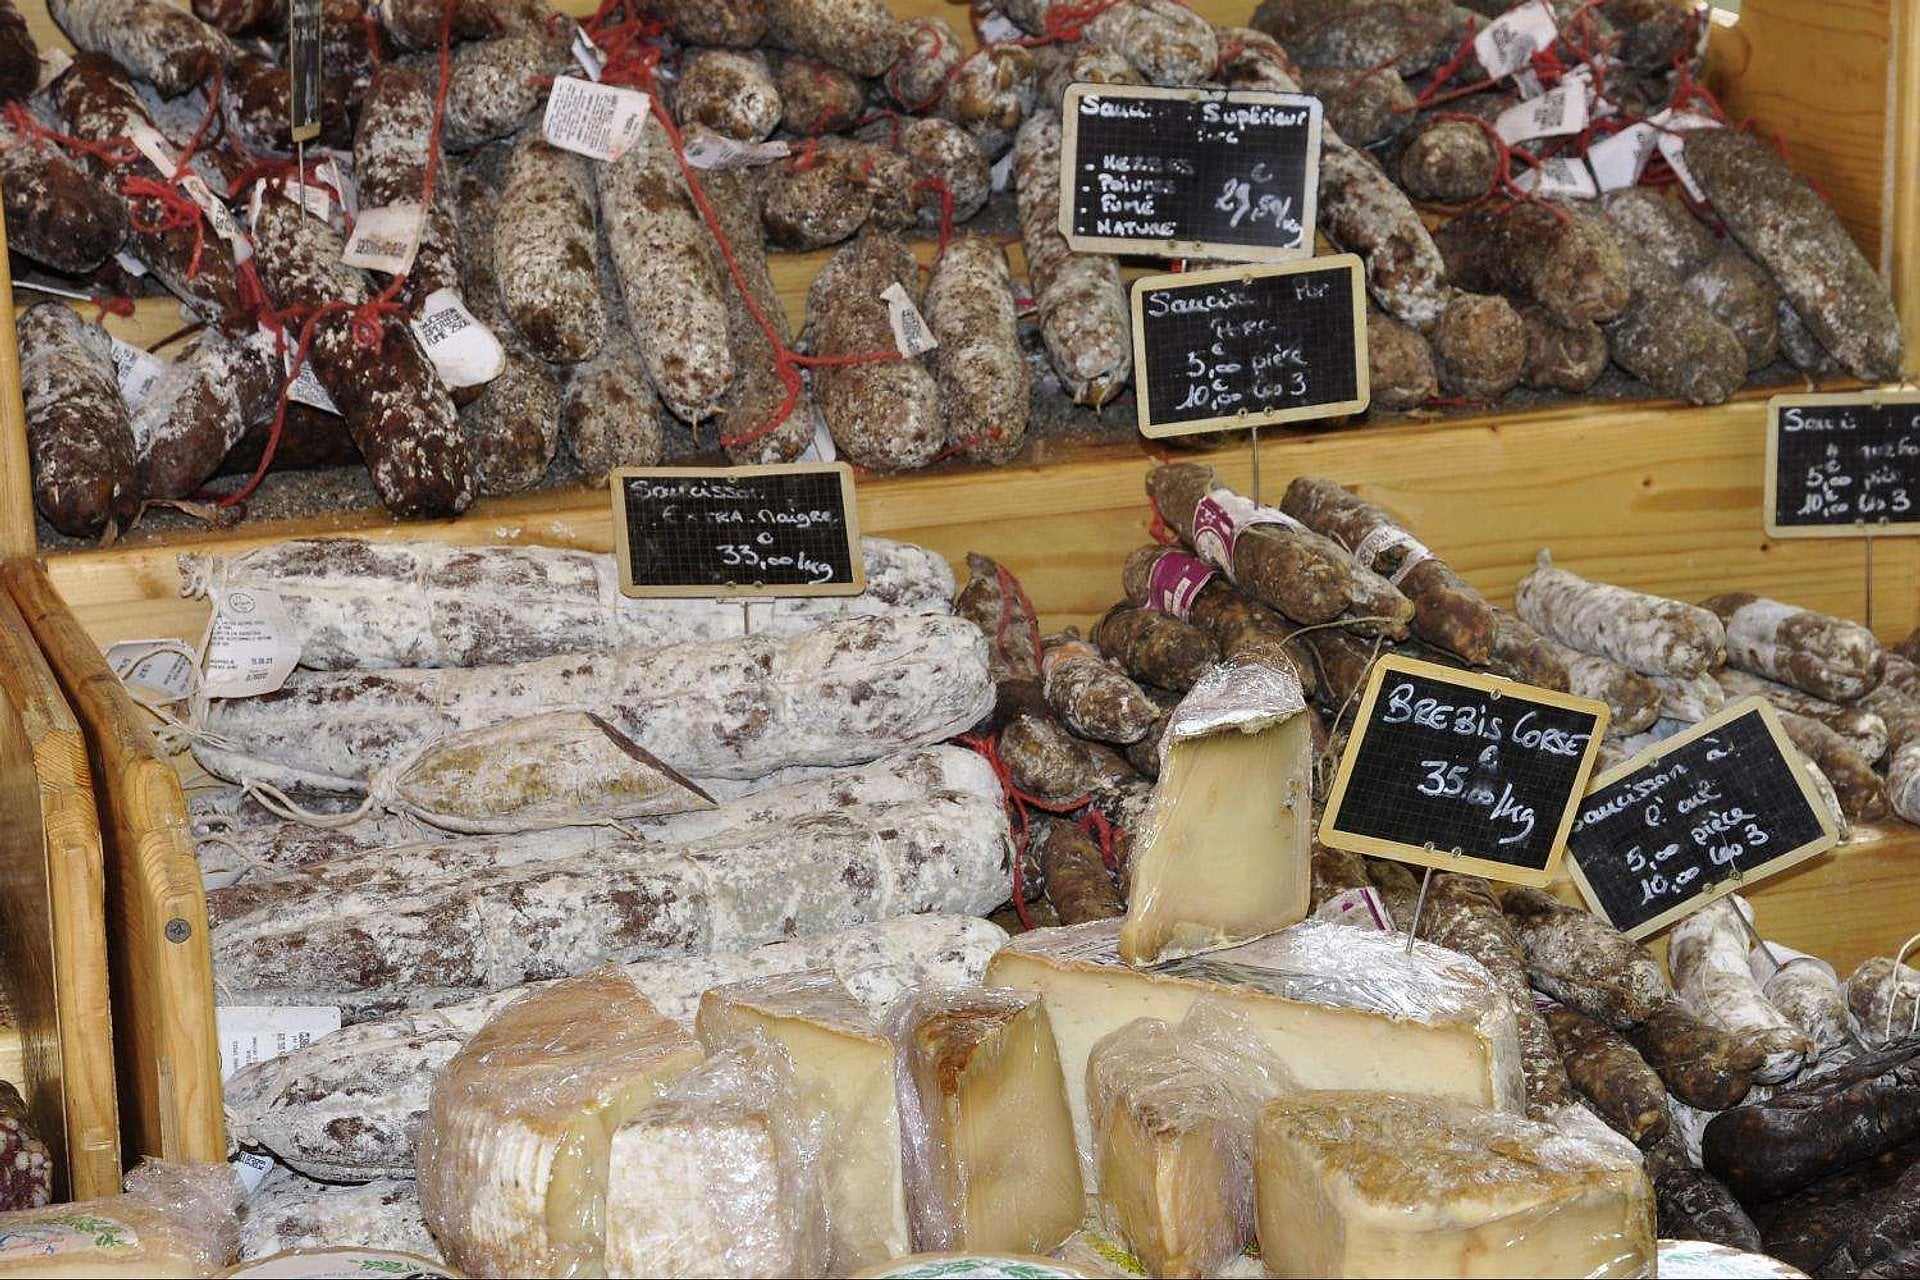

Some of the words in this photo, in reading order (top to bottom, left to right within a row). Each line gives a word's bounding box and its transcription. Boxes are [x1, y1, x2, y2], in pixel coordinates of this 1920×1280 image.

[1290, 372, 1306, 396] 3
[1890, 488, 1912, 513] 3
[1744, 822, 1769, 847] 3
